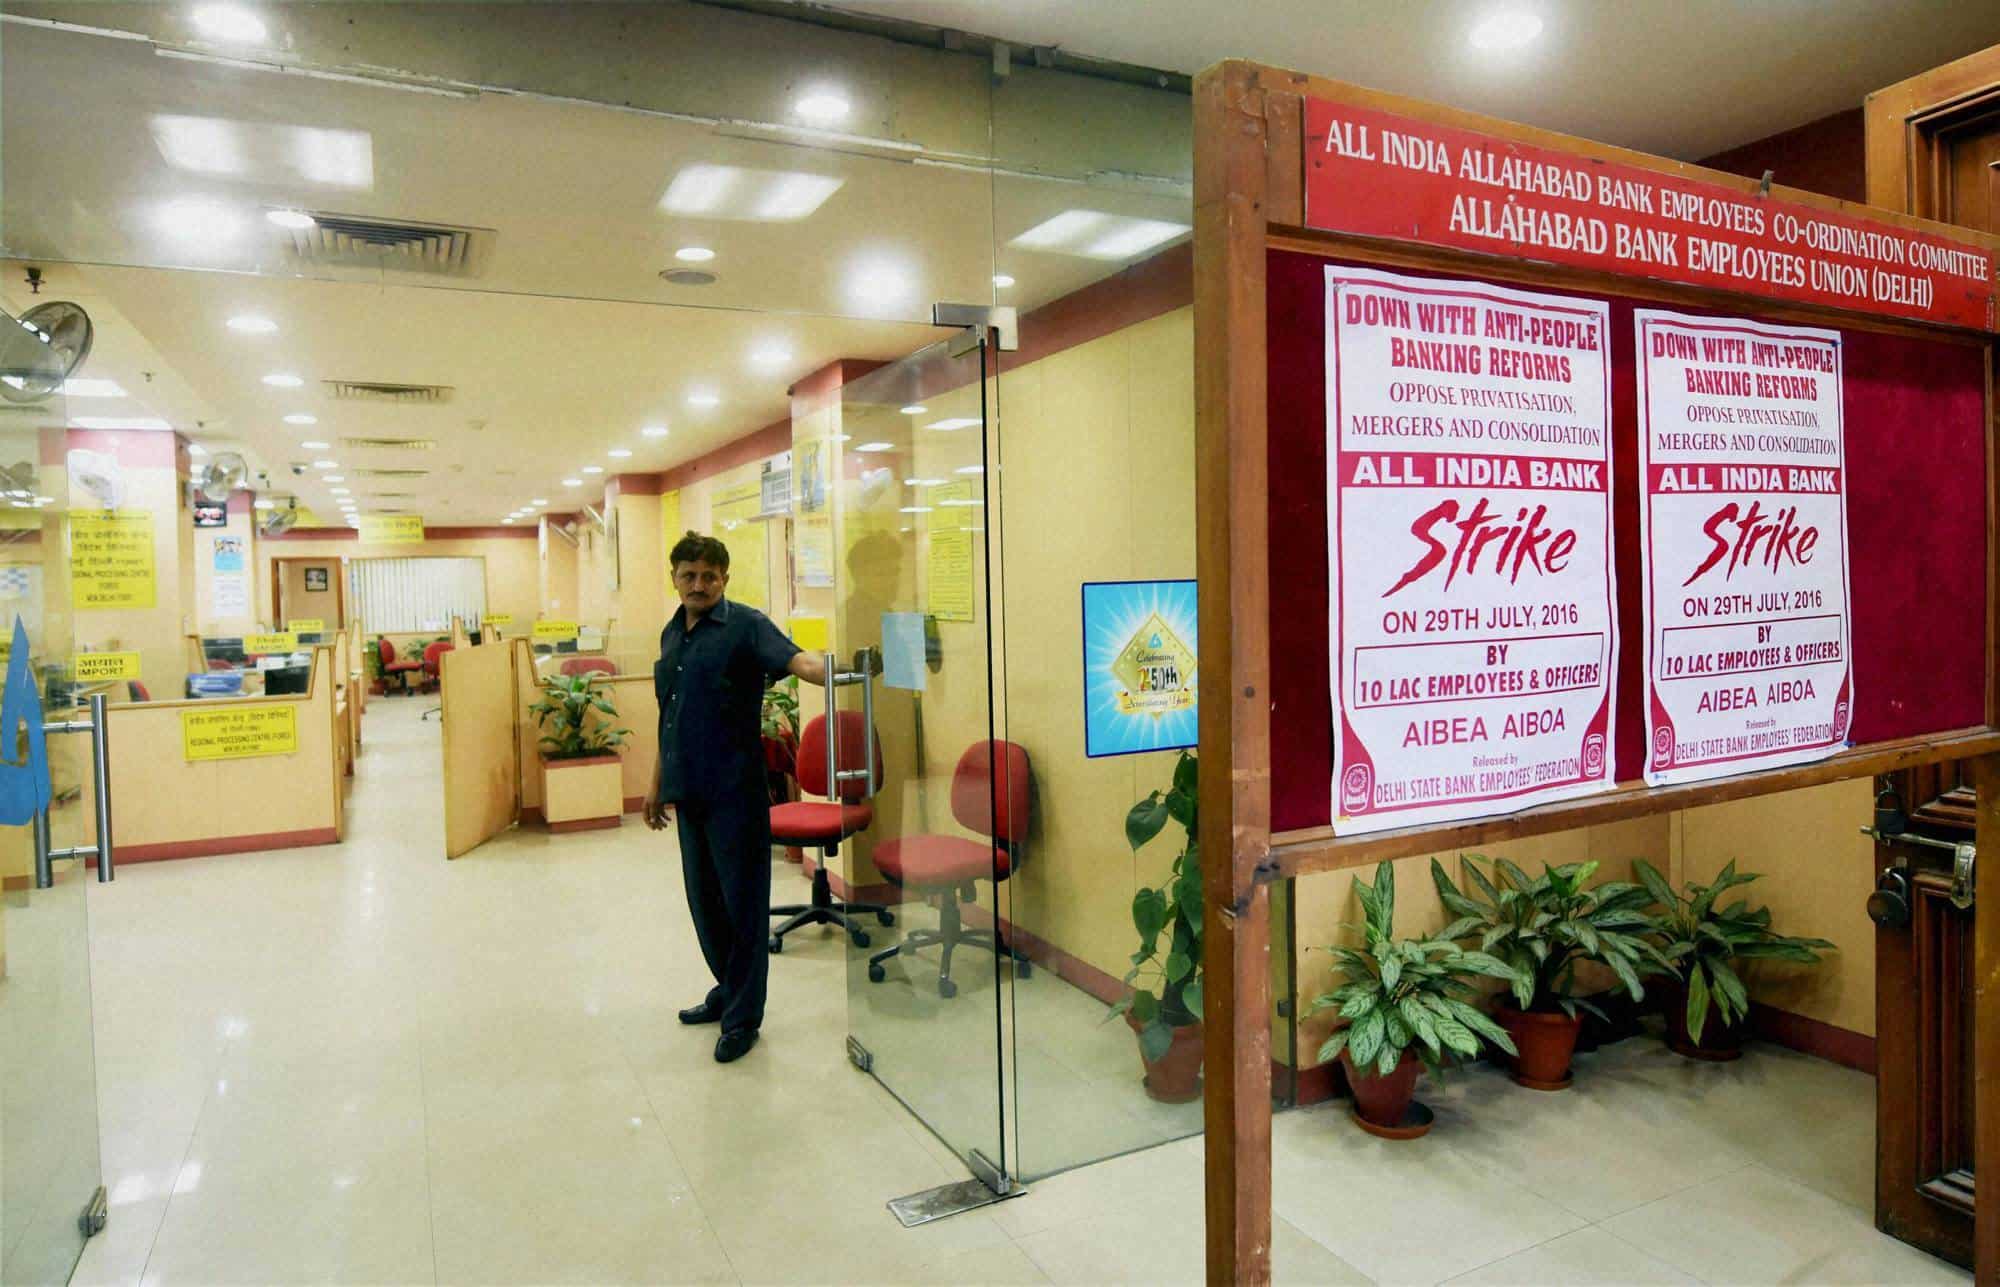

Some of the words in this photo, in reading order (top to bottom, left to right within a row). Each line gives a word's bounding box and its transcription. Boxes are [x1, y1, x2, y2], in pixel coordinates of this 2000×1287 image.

[1325, 119, 1375, 160] ALL
[1381, 130, 1451, 176] INDIA
[1459, 147, 1592, 202] ALLAHABAD
[1598, 175, 1654, 215] BANK
[1660, 188, 1765, 237] EMPLOYEES
[1773, 213, 1905, 265] CO-ORDINATION
[1908, 240, 1989, 281] COMMITTEE
[1449, 194, 1607, 255] ALLAHABAD
[1615, 223, 1678, 268] BANK
[1687, 236, 1805, 288] EMPLOYEES
[1809, 259, 1868, 298] UNION
[1872, 266, 1934, 310] (DELHI)
[1345, 294, 1411, 330] DOWN
[1417, 302, 1476, 336] WITH
[1484, 309, 1598, 351] ANTI-PEOPLE
[1391, 336, 1481, 375] BANKING
[1489, 346, 1572, 383] REFORMS
[1652, 332, 1698, 361] DOWN
[1702, 337, 1747, 365] WITH
[1752, 341, 1834, 374] ANTI-PEOPLE
[1390, 382, 1456, 406] OPPOSE
[1461, 388, 1577, 416] PRIVATISATION,
[1685, 367, 1751, 398] BANKING
[1756, 373, 1817, 402] REFORMS
[1351, 415, 1444, 437] MERGERS
[1448, 418, 1483, 440] AND
[1488, 420, 1601, 447] CONSOLIDATION
[1687, 404, 1736, 424] OPPOSE
[1658, 432, 1727, 451] MERGERS
[1730, 434, 1755, 452] AND
[1758, 435, 1837, 456] CONSOLIDATION
[1352, 456, 1424, 484] ALL
[1435, 458, 1522, 487] INDIA
[1530, 461, 1601, 489] BANK
[1659, 467, 1713, 491] ALL
[1722, 468, 1783, 491] INDIA
[1789, 469, 1837, 492] BANK
[1380, 497, 1577, 598] Strike
[1682, 500, 1819, 587] Strike
[1383, 610, 1417, 634] ON
[1424, 607, 1479, 632] 29TH
[1486, 605, 1537, 630] JULY,
[1541, 603, 1578, 627] 2016
[1683, 597, 1708, 618] ON
[1714, 594, 1752, 616] 29TH
[1757, 592, 1792, 613] JULY,
[1794, 590, 1822, 609] 2016
[1758, 626, 1772, 643] BY
[1486, 644, 1508, 666] BY
[1666, 656, 1683, 675] 10
[1688, 654, 1713, 673] LAC
[1718, 647, 1780, 671] EMPLOYEES
[1784, 646, 1792, 663] &
[1795, 641, 1840, 662] OFFICERS
[1360, 680, 1382, 703] 10
[1390, 677, 1420, 700] LAC
[1428, 669, 1523, 697] EMPLOYEES
[1529, 668, 1540, 689] &
[1545, 663, 1599, 690] OFFICERS
[1697, 686, 1758, 714] AIBEA
[1766, 679, 1816, 706] AIBOA
[1402, 716, 1488, 748] AIBEA
[1502, 707, 1565, 740] AIBOA
[1676, 743, 1698, 761] DELHI
[1701, 741, 1724, 758] STATE
[1726, 738, 1749, 755] BANK
[1794, 723, 1834, 744] FEDERATION
[1472, 753, 1508, 768] Released
[1510, 752, 1518, 767] by
[1376, 780, 1407, 804] DELHI
[1411, 777, 1441, 801] STATE
[1446, 776, 1476, 799] BANK
[1480, 766, 1534, 793] EMPLOYEES'
[1535, 757, 1580, 782] FEDERATION
